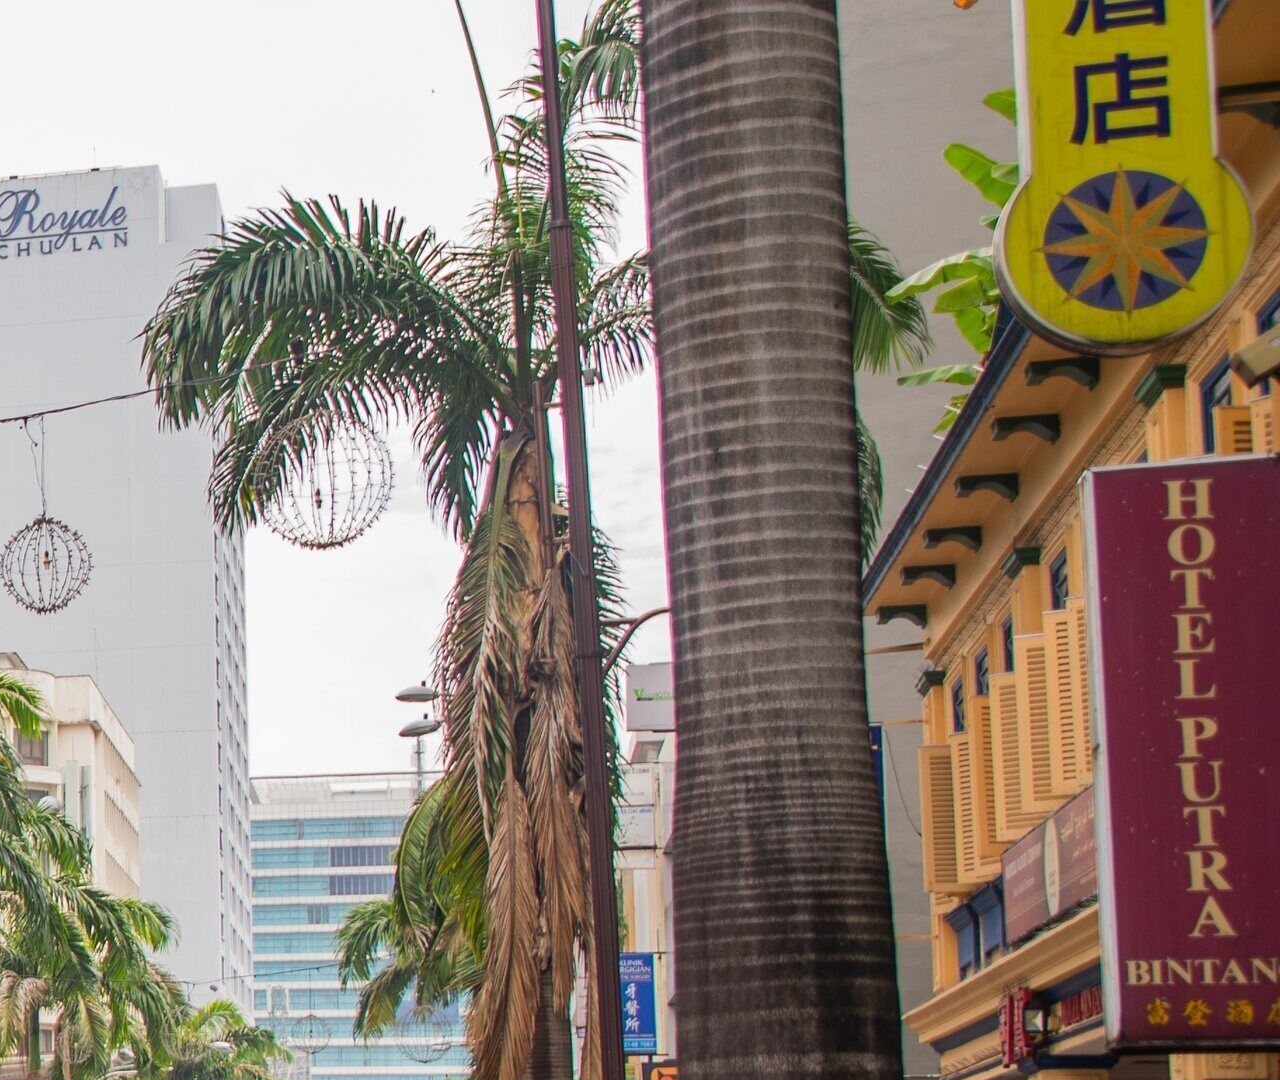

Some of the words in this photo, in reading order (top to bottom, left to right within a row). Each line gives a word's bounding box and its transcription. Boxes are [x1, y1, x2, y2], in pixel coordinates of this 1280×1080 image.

[1164, 478, 1218, 702] HOTEL
[1174, 715, 1239, 939] PUTRA
[1126, 957, 1280, 986] BINTAN
